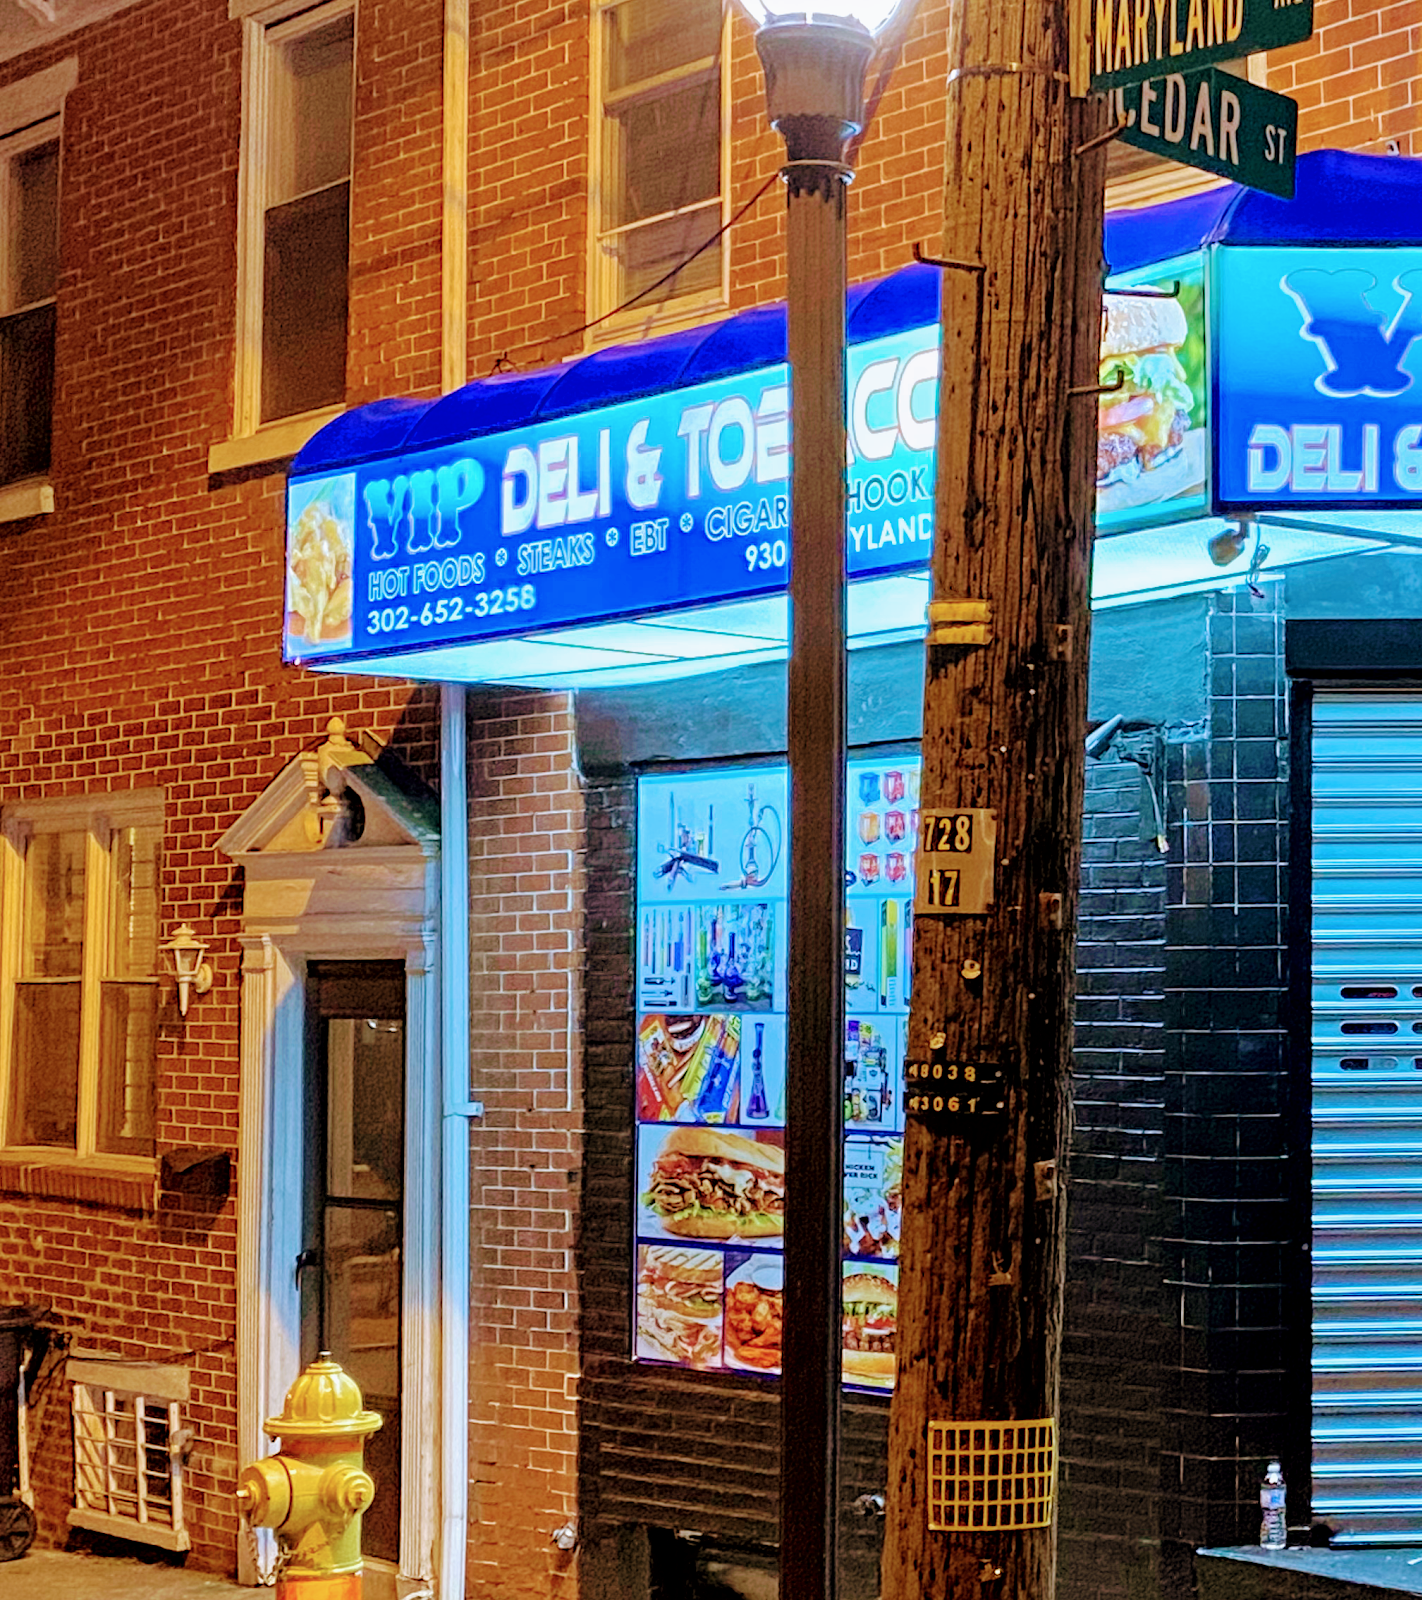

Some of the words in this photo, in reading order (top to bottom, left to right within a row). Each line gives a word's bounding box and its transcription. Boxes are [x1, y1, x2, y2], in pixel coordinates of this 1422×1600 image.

[1095, 0, 1244, 75] MARYLAND
[1115, 73, 1240, 165] CEDAR
[1265, 124, 1287, 165] ST
[501, 430, 611, 536] DELI
[625, 417, 663, 510] &
[1247, 423, 1379, 493] DELI
[364, 457, 485, 561] VIP
[367, 569, 410, 602] HOT
[412, 556, 485, 592] FOODS
[517, 531, 595, 576] STEAKS
[631, 517, 669, 556] EBT
[705, 495, 788, 543] CIGAR
[745, 540, 786, 572] 930
[849, 513, 932, 552] YLAND
[366, 585, 537, 635] 302-652-3258
[924, 815, 971, 852] 728
[929, 870, 958, 906] 17
[908, 1063, 977, 1082] 48038
[908, 1095, 977, 1113] 43061
